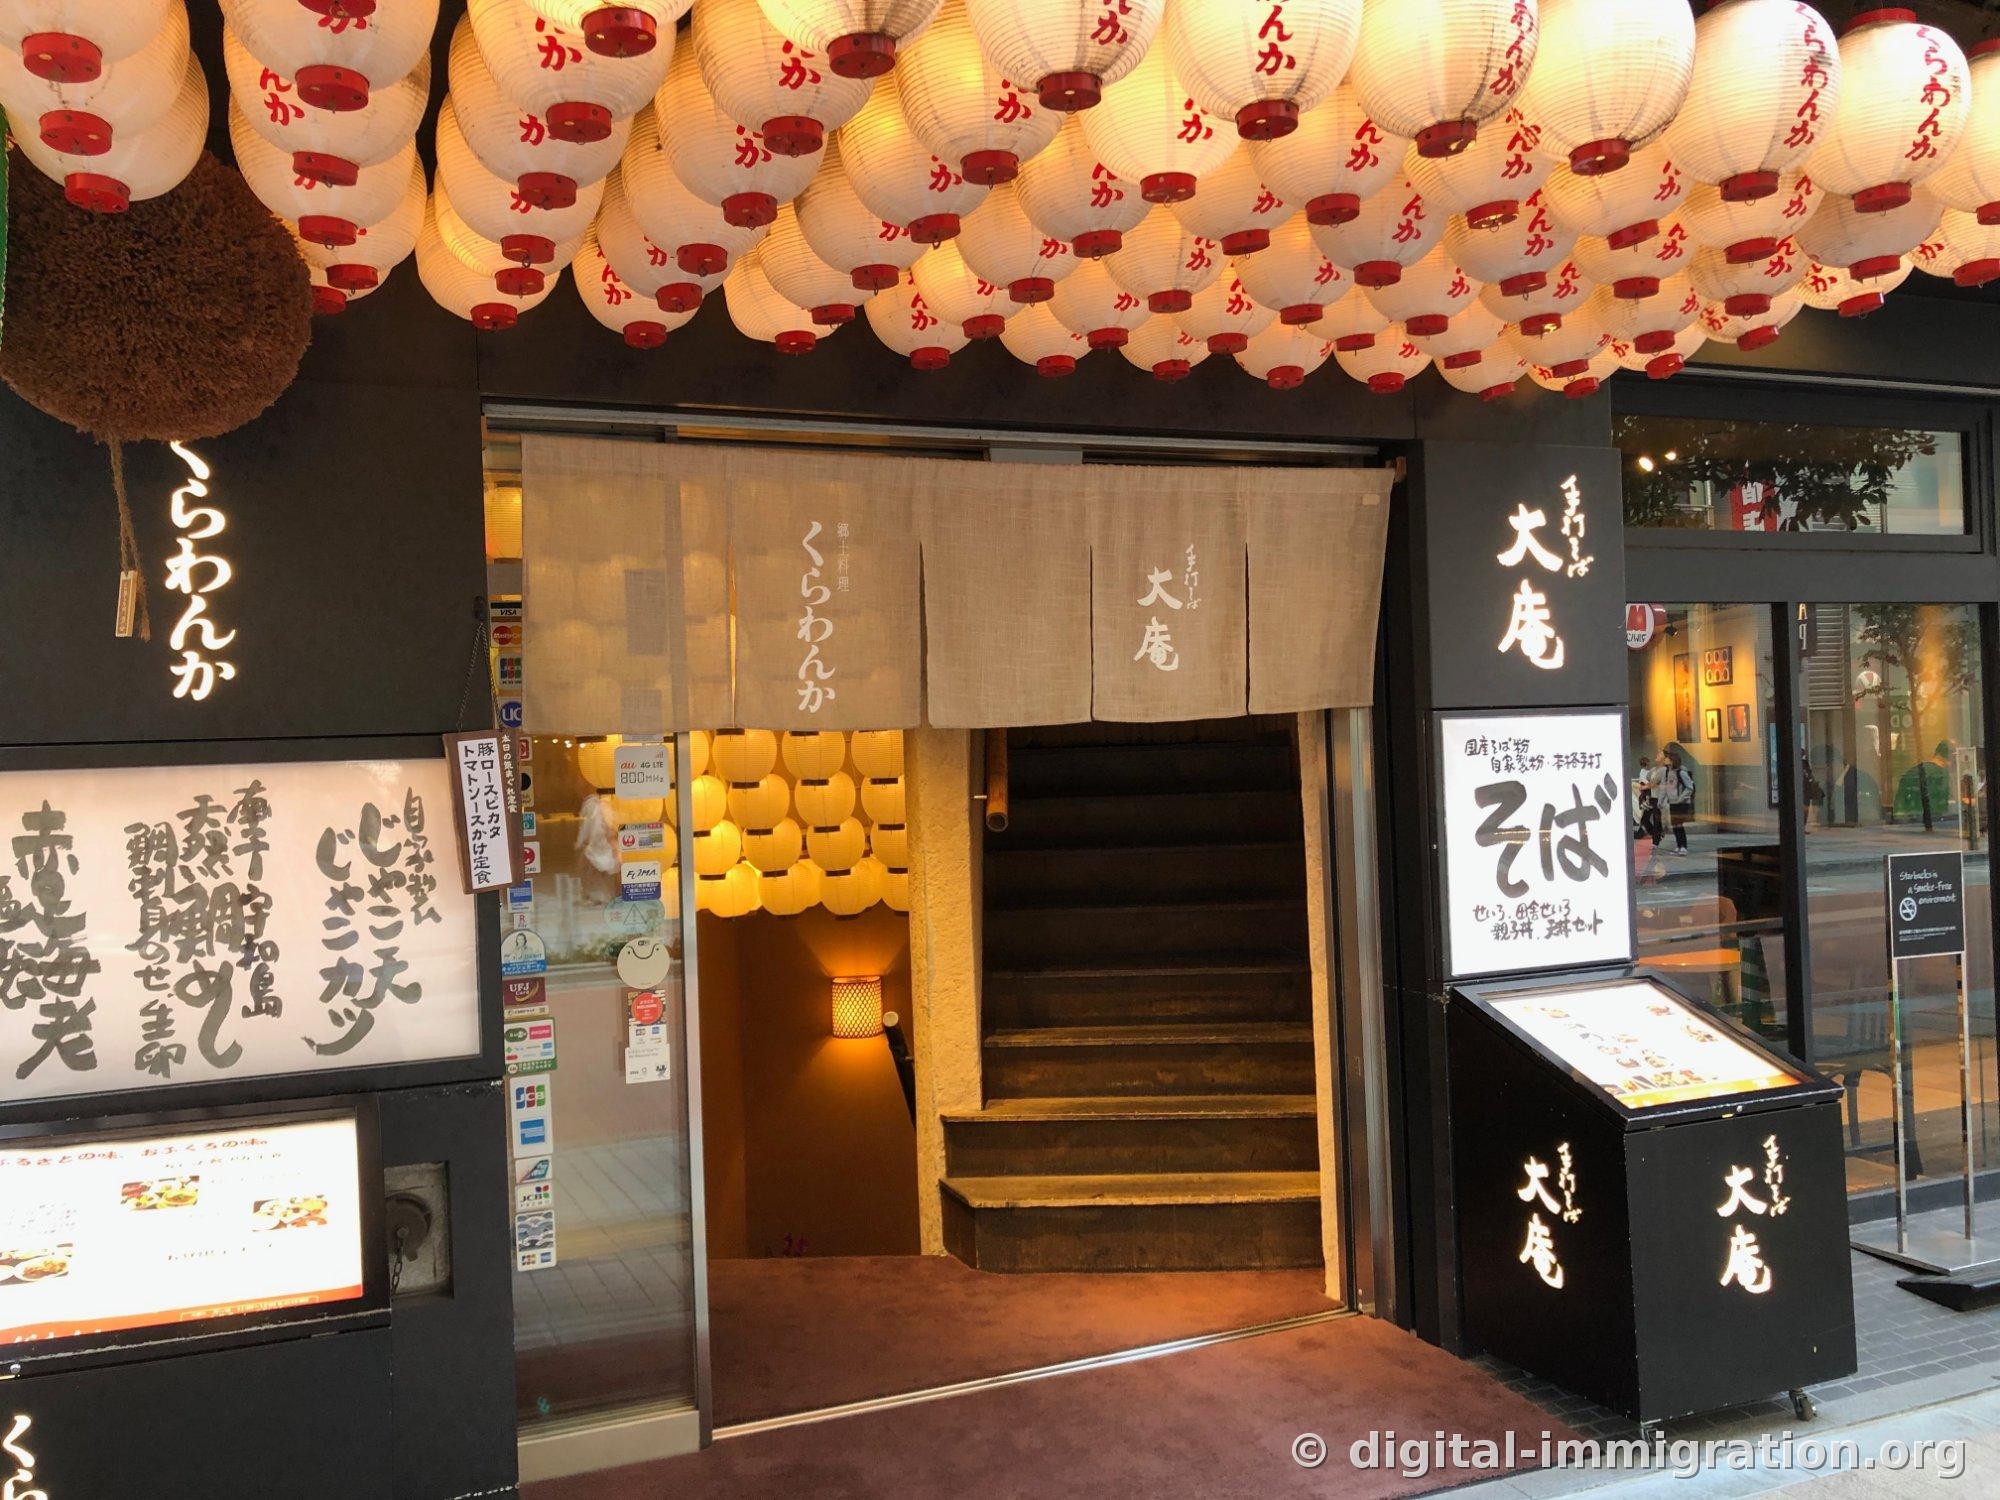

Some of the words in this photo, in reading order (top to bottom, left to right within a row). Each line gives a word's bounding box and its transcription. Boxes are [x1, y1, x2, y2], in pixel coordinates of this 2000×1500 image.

[1345, 118, 1383, 172] んか
[1904, 26, 1951, 162] くらわんか
[1251, 184, 1283, 214] か
[836, 521, 850, 593] 郷土料理
[1497, 503, 1564, 670] 大庵
[797, 520, 836, 713] くらわんか
[1133, 566, 1183, 672] 大庵
[463, 745, 492, 885] トマトソースかけ定食
[477, 742, 501, 840] 豚ロースピカタ
[620, 762, 637, 770] au
[652, 761, 664, 769] LTE
[1474, 772, 1618, 899] そば
[509, 982, 530, 992] UFJ
[1517, 1155, 1565, 1290] 大庵
[1717, 1164, 1773, 1294] 大庵
